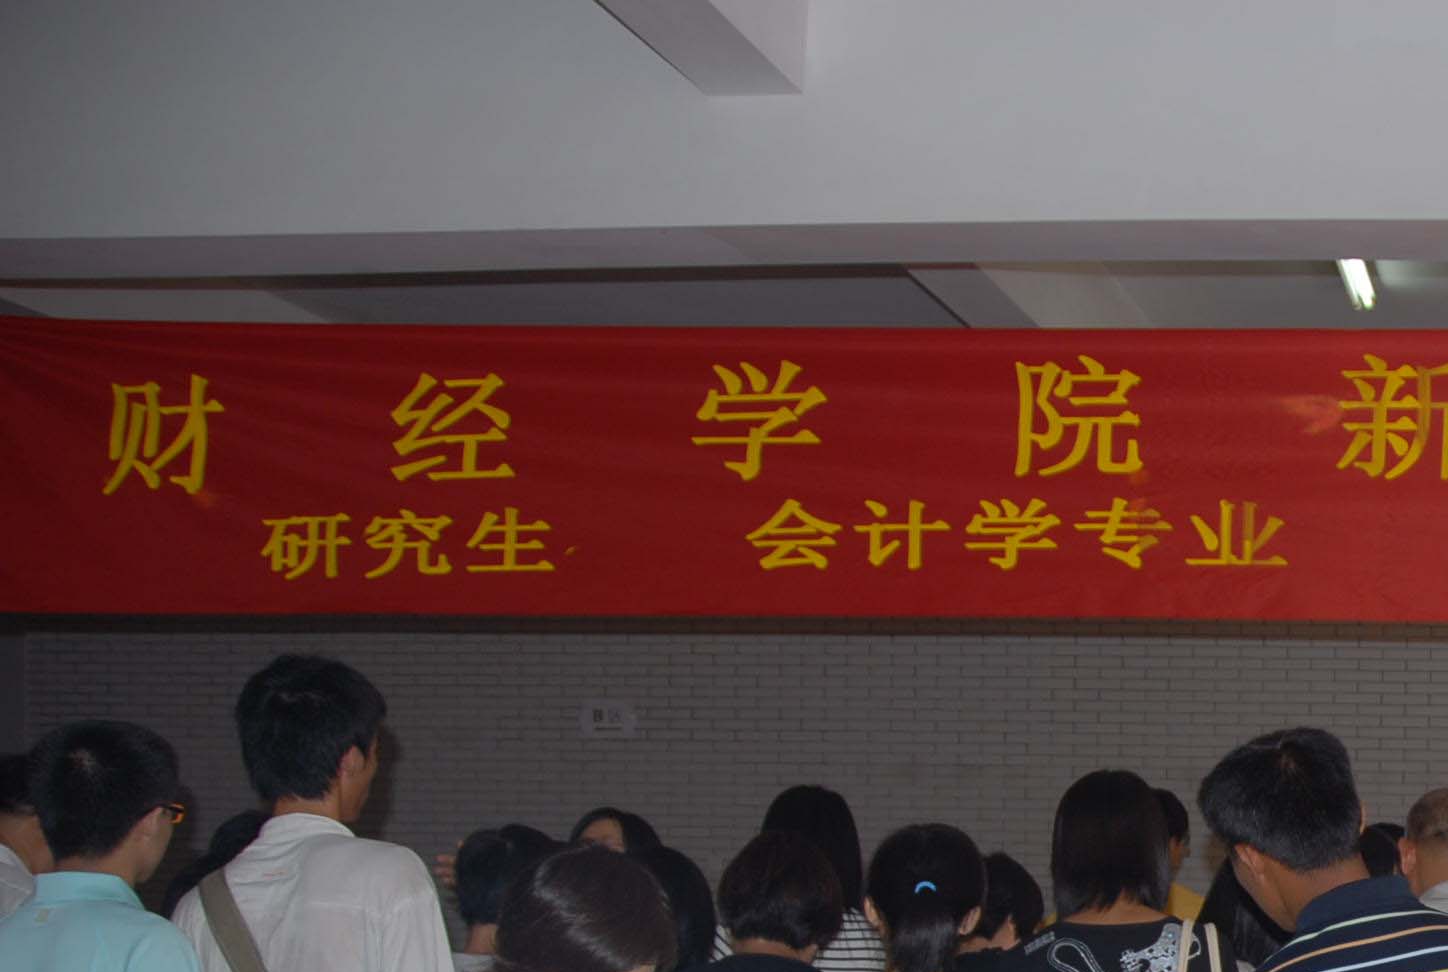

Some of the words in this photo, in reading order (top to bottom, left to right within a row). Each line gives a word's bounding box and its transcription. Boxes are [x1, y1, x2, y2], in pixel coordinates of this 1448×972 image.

[262, 508, 555, 580] 研究生
[746, 498, 1287, 570] 会计学专业
